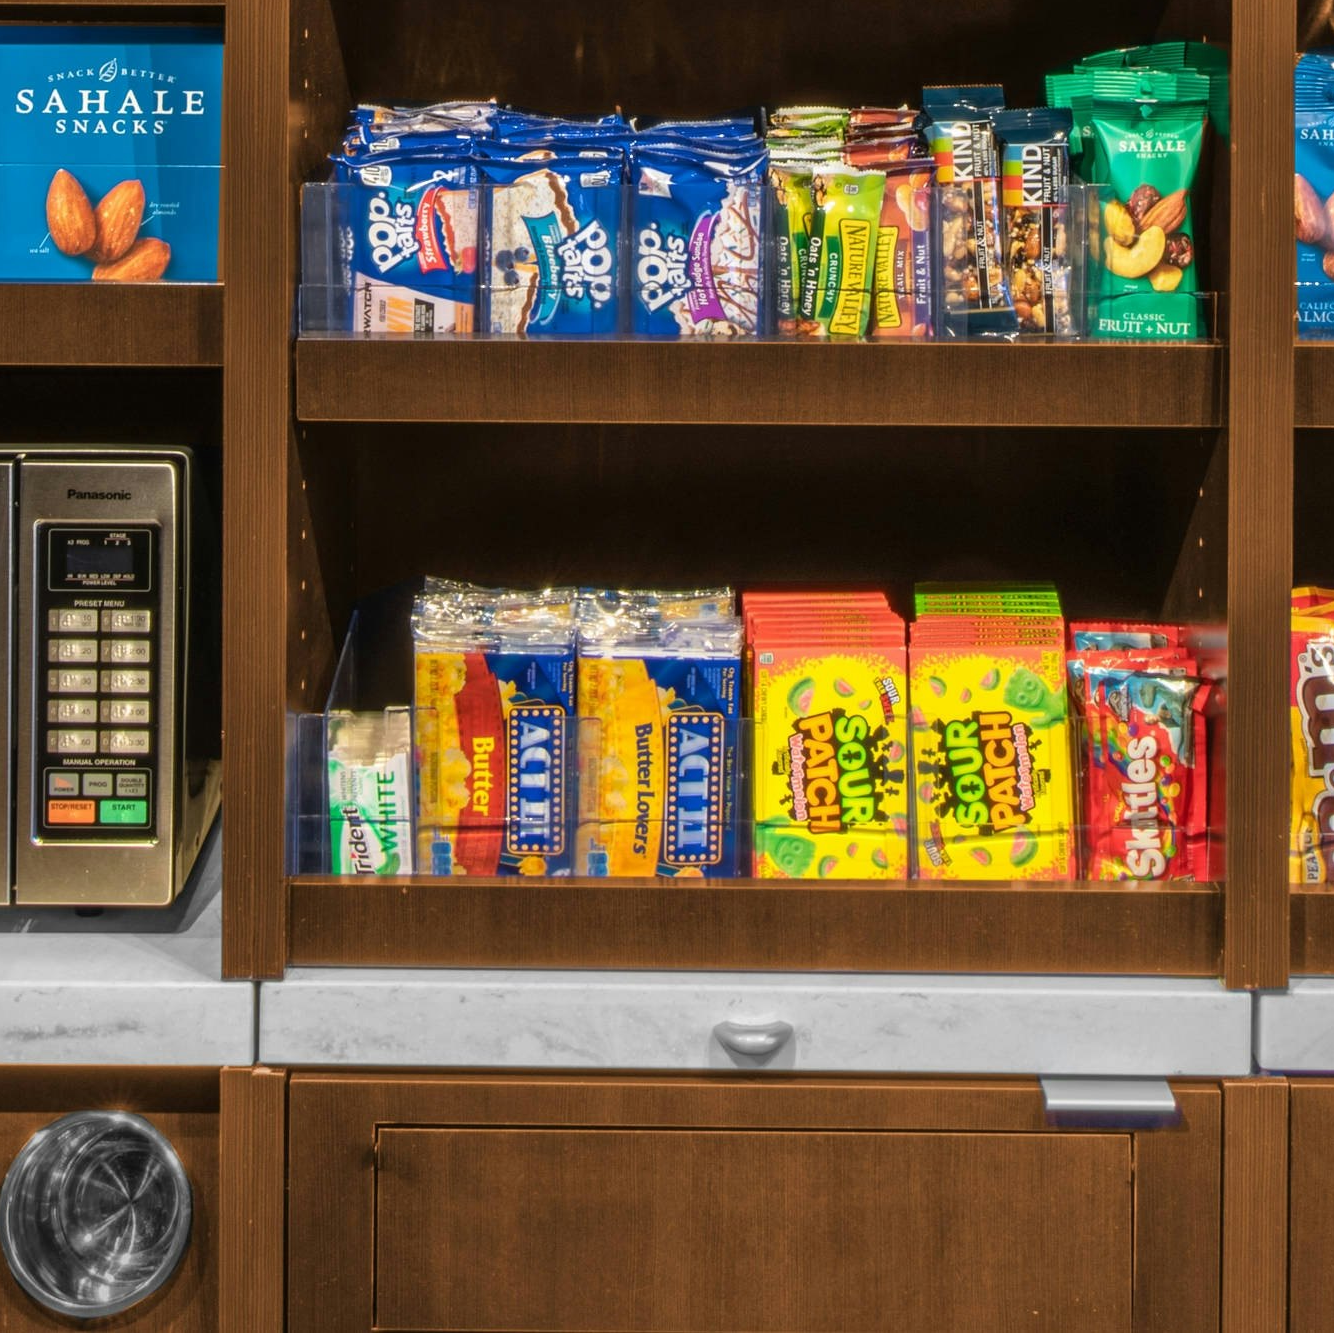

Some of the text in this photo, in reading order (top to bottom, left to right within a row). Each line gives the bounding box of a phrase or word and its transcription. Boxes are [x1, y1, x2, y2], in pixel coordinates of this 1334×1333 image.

[15, 88, 206, 115] SAHALE
[47, 68, 177, 84] SNACK BETTER
[55, 119, 165, 135] SNACKS
[952, 121, 974, 182] KIND
[1119, 140, 1186, 153] SAHALE
[1022, 144, 1043, 206] KIND
[419, 202, 437, 264] Strawberry
[809, 237, 821, 265] Oats
[540, 234, 557, 301] Blueberry
[827, 252, 839, 304] CRUNCHY
[834, 224, 868, 334] NATURE VALLEY
[1098, 318, 1191, 335] FRUIT NUT
[1123, 312, 1166, 321] CLASSIC
[67, 488, 132, 500] Panasonic
[74, 599, 125, 608] PRESET MENU
[62, 758, 136, 766] MANUAL OPERATION
[471, 736, 495, 816] Butter
[519, 720, 552, 792] ACT
[678, 728, 709, 798] ACT
[788, 733, 808, 823] Watermelon
[799, 711, 842, 835] PATCH
[833, 714, 876, 824] SOUR
[944, 719, 989, 827] SOUR
[979, 710, 1019, 833] PATCH
[1013, 723, 1035, 812] Watermelon
[51, 802, 136, 811] STOP/RESET START
[373, 770, 396, 854] WHITE
[632, 722, 655, 856] Butter Lovers
[1124, 734, 1167, 878] Skittles
